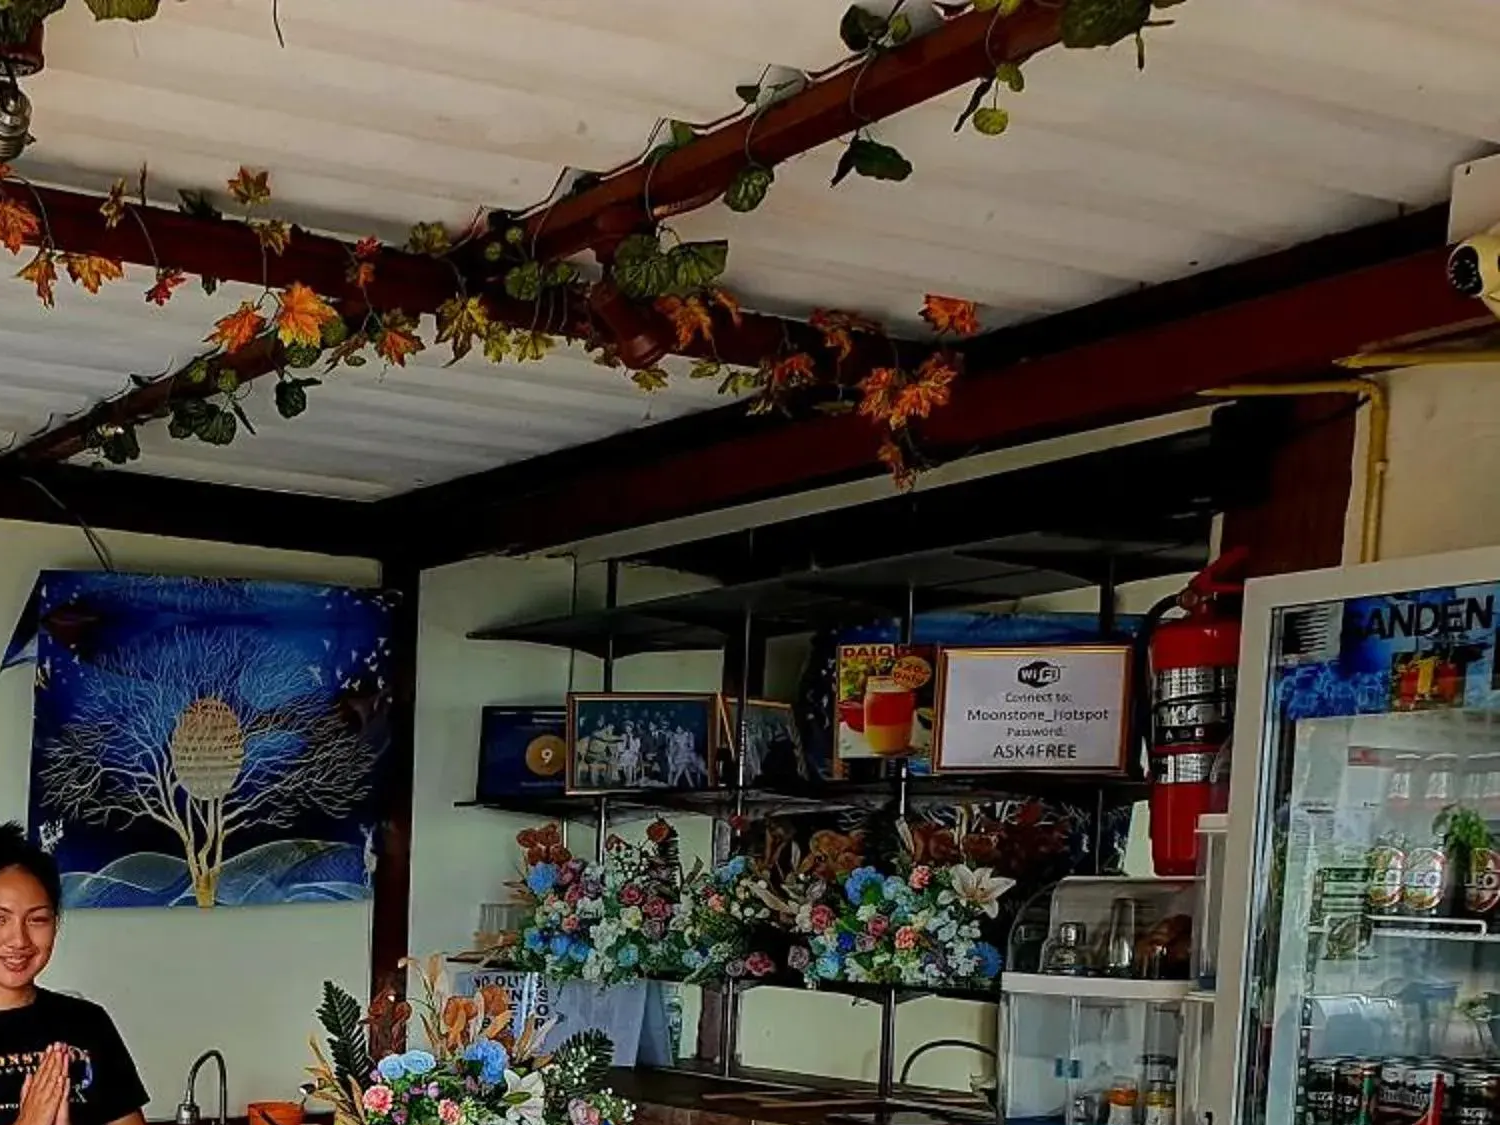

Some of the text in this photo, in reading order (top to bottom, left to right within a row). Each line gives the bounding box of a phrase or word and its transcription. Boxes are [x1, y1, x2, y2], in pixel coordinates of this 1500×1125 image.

[1005, 692, 1052, 703] Connect
[967, 708, 1109, 723] Moonstone_Hotspot
[541, 748, 553, 763] 9
[993, 743, 1077, 759] ASK4FREE
